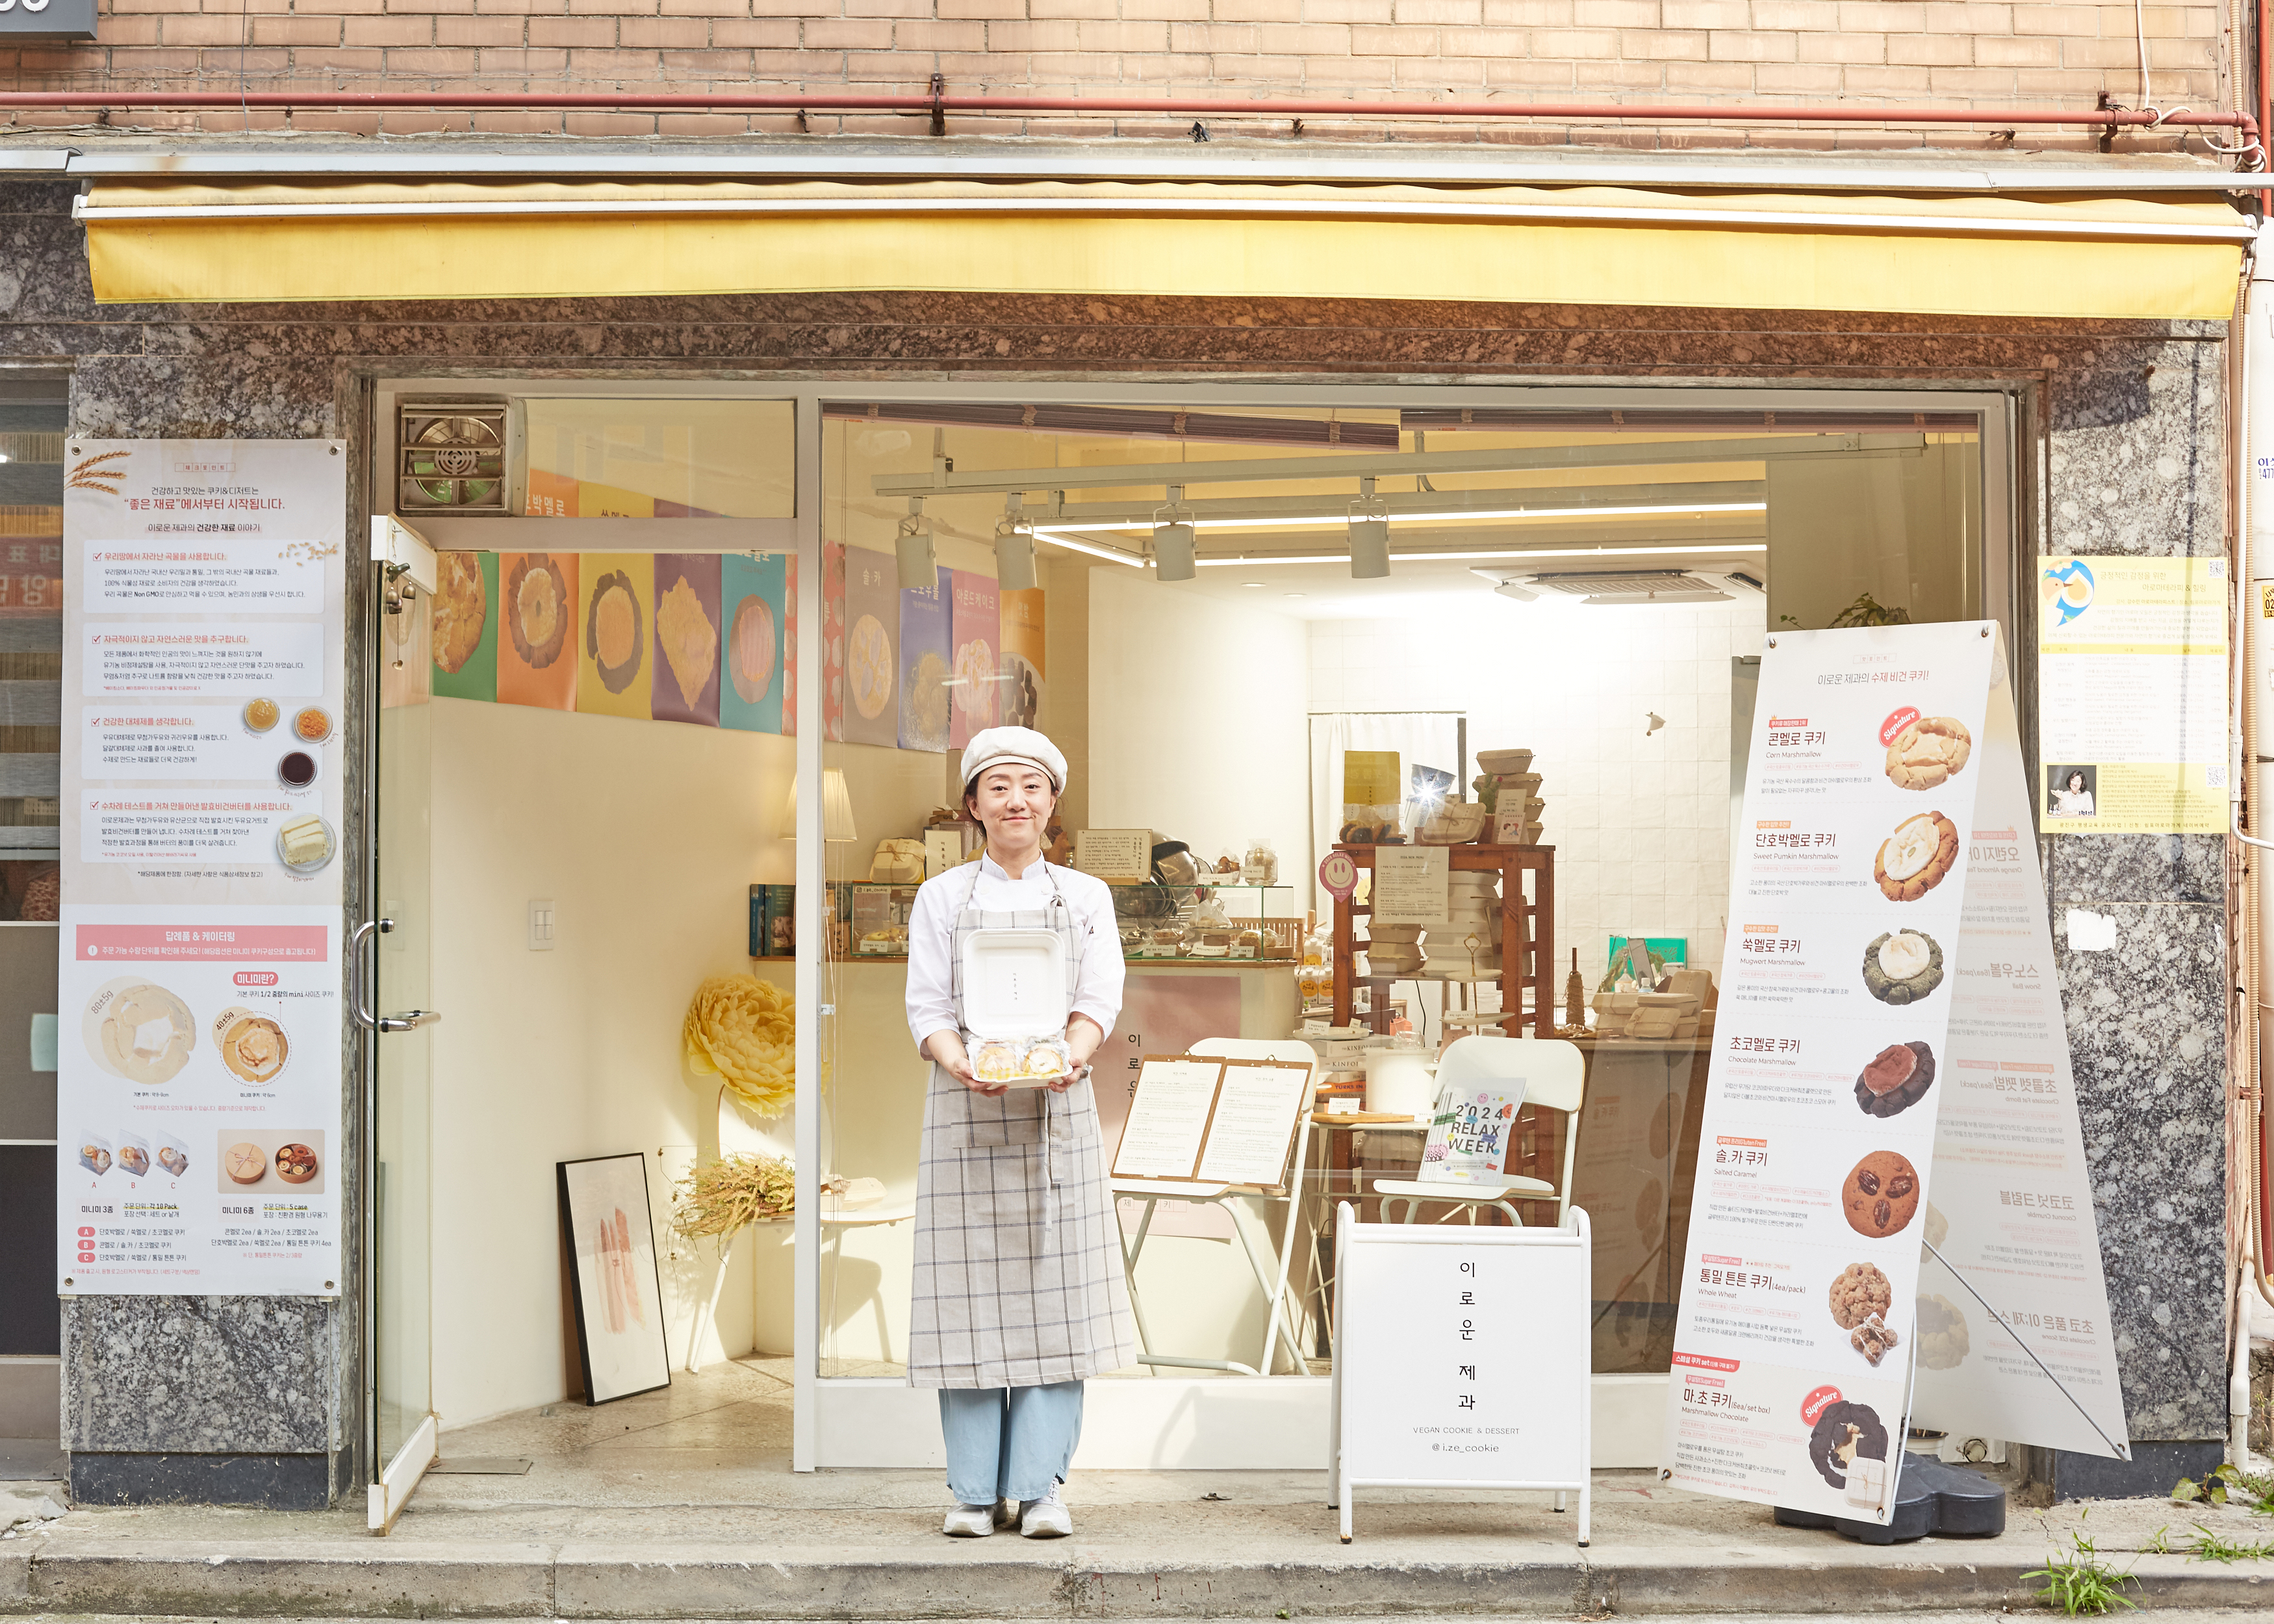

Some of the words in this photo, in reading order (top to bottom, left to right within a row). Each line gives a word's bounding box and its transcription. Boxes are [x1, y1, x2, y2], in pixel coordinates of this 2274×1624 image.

[151, 487, 181, 495] 건강하고
[183, 487, 205, 495] 맛있는
[207, 487, 258, 495] 쿠키&디저트는
[227, 498, 285, 510] 시작됩니다.
[147, 523, 170, 531] 이로운
[237, 523, 259, 531] 이야기
[105, 552, 140, 561] 우리땅에서
[142, 552, 163, 561] 자라난
[188, 552, 226, 561] 사용합니다.
[2193, 584, 2206, 592] 힐링
[956, 588, 995, 610] 아몬드케이크
[104, 635, 138, 643] 자극적이지
[141, 635, 155, 643] 않고
[157, 635, 192, 643] 자연스러운
[194, 635, 207, 643] 맛을
[210, 635, 248, 643] 추구합니다.
[1817, 674, 1842, 685] 이로운
[1844, 672, 1869, 683] 제과의
[1871, 672, 1888, 683] 수제
[1889, 671, 1906, 681] 비건
[1909, 670, 1928, 681] 쿠키!
[103, 717, 123, 726] 건강한
[155, 717, 193, 726] 생각합니다.
[1883, 709, 1916, 741] Signature
[1769, 732, 1800, 746] 콘멜로
[1804, 731, 1825, 745] 쿠키
[1756, 833, 1810, 847] 단호박멜로
[1814, 833, 1835, 847] 쿠키
[165, 931, 189, 941] 답례품
[192, 931, 199, 941] &
[201, 931, 235, 941] 케이터링
[1743, 938, 1775, 952] 쑥멜로
[1779, 939, 1800, 953] 쿠키
[237, 974, 274, 984] 미니미란?
[216, 1011, 235, 1031] 40±5g
[1730, 1036, 1774, 1051] 초코멜로
[1778, 1039, 1800, 1053] 쿠키
[1456, 1105, 1503, 1121] 2024
[1451, 1122, 1500, 1137] RELAX
[1449, 1138, 1497, 1153] WEEK
[1716, 1148, 1743, 1164] 솔.카
[1745, 1151, 1767, 1166] 쿠키
[1700, 1268, 1722, 1284] 통밀
[1726, 1271, 1746, 1287] 튼튼
[1459, 1262, 1475, 1339] 이로운
[1718, 1290, 1736, 1299] Wheat
[1676, 1355, 1690, 1364] 스페셜
[1691, 1356, 1700, 1365] 쿠키
[1459, 1365, 1475, 1410] 제과
[1683, 1389, 1707, 1404] 마.초
[1757, 1406, 1770, 1414] box)
[1805, 1390, 1838, 1418] Signature
[1681, 1406, 1718, 1417] Marshmallow
[1720, 1412, 1748, 1421] Chocolate
